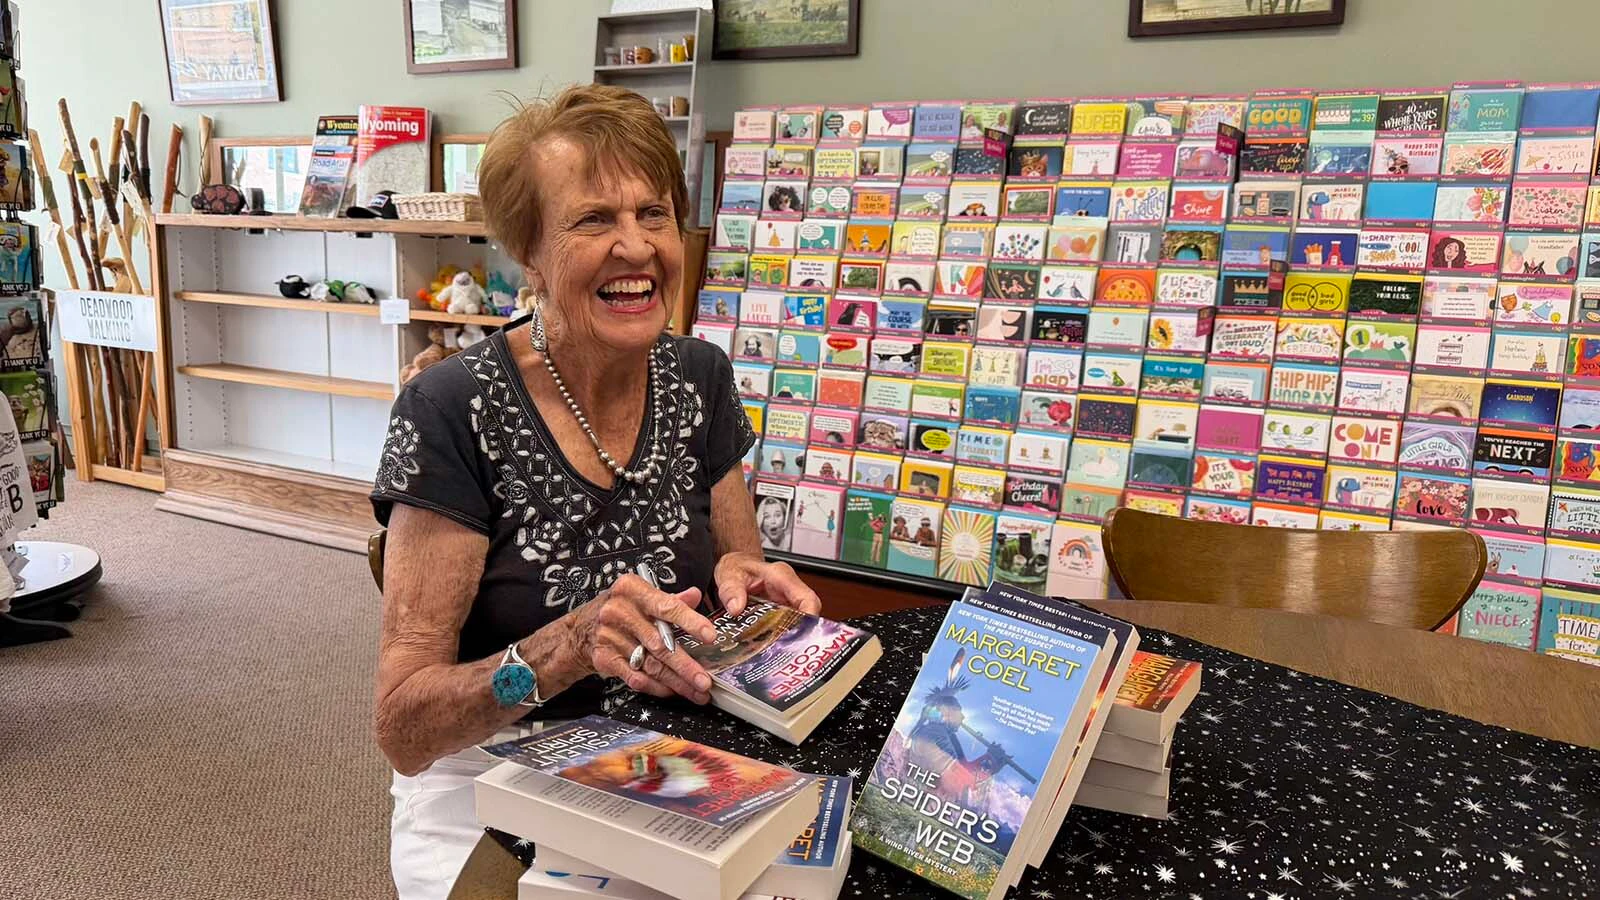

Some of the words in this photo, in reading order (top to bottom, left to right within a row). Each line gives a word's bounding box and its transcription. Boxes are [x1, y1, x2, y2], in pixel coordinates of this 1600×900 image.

[326, 119, 359, 130] Wyomin
[1250, 109, 1302, 125] GOOD
[1413, 108, 1438, 123] YEARS
[1183, 203, 1213, 216] Shine
[1535, 205, 1566, 215] Sister
[1369, 234, 1395, 242] SMART
[1398, 241, 1422, 253] COOL
[80, 297, 133, 320] DEADWOOD
[87, 319, 131, 342] WALKING
[1279, 371, 1305, 388] HIP
[1307, 373, 1332, 391] HIP
[960, 433, 992, 444] TIME
[1335, 423, 1393, 445] COME
[1343, 442, 1380, 461] ON!
[1428, 441, 1454, 453] GIRLS
[1490, 444, 1536, 461] NEXT
[1010, 481, 1049, 492] Birthday
[1011, 491, 1043, 503] Cheers!
[1416, 499, 1446, 516] love
[1567, 512, 1600, 523] LITTL
[999, 590, 1012, 598] NEW
[1012, 595, 1028, 606] YORK
[1028, 599, 1044, 611] TIMES
[730, 603, 775, 639] NIGHT
[970, 598, 983, 606] NEW
[983, 600, 999, 611] YORK
[999, 606, 1017, 617] TIMES
[1017, 612, 1057, 630] BESTSELLING
[1057, 625, 1083, 638] AUTHOR
[1083, 633, 1094, 641] OF
[1474, 609, 1520, 628] NIECE
[957, 609, 973, 618] NEW
[973, 612, 989, 624] YORK
[988, 616, 1008, 630] TIMES
[1008, 623, 1049, 643] BESTSELLING
[1050, 634, 1076, 650] AUTHOR
[1075, 645, 1087, 654] OF
[983, 624, 999, 634] THE
[998, 626, 1025, 642] PERFECT
[1023, 635, 1054, 650] SUSPECT
[1560, 619, 1599, 640] TIME
[945, 623, 1082, 680] MARGARET
[1568, 639, 1585, 652] for
[773, 644, 820, 678] COEL
[967, 655, 1032, 692] COEL
[527, 729, 595, 756] SPIRIT
[600, 726, 635, 740] THE
[532, 738, 610, 767] SILENT
[907, 763, 941, 789] THE
[828, 798, 836, 811] TIMES
[879, 777, 1000, 845] SPIDER'S
[821, 810, 832, 840] BESTSELLING
[815, 840, 825, 859] AUTHOR
[915, 820, 976, 865] WEB
[885, 839, 903, 853] WIND
[903, 846, 925, 862] RIVER
[924, 855, 958, 877] MYSTERY
